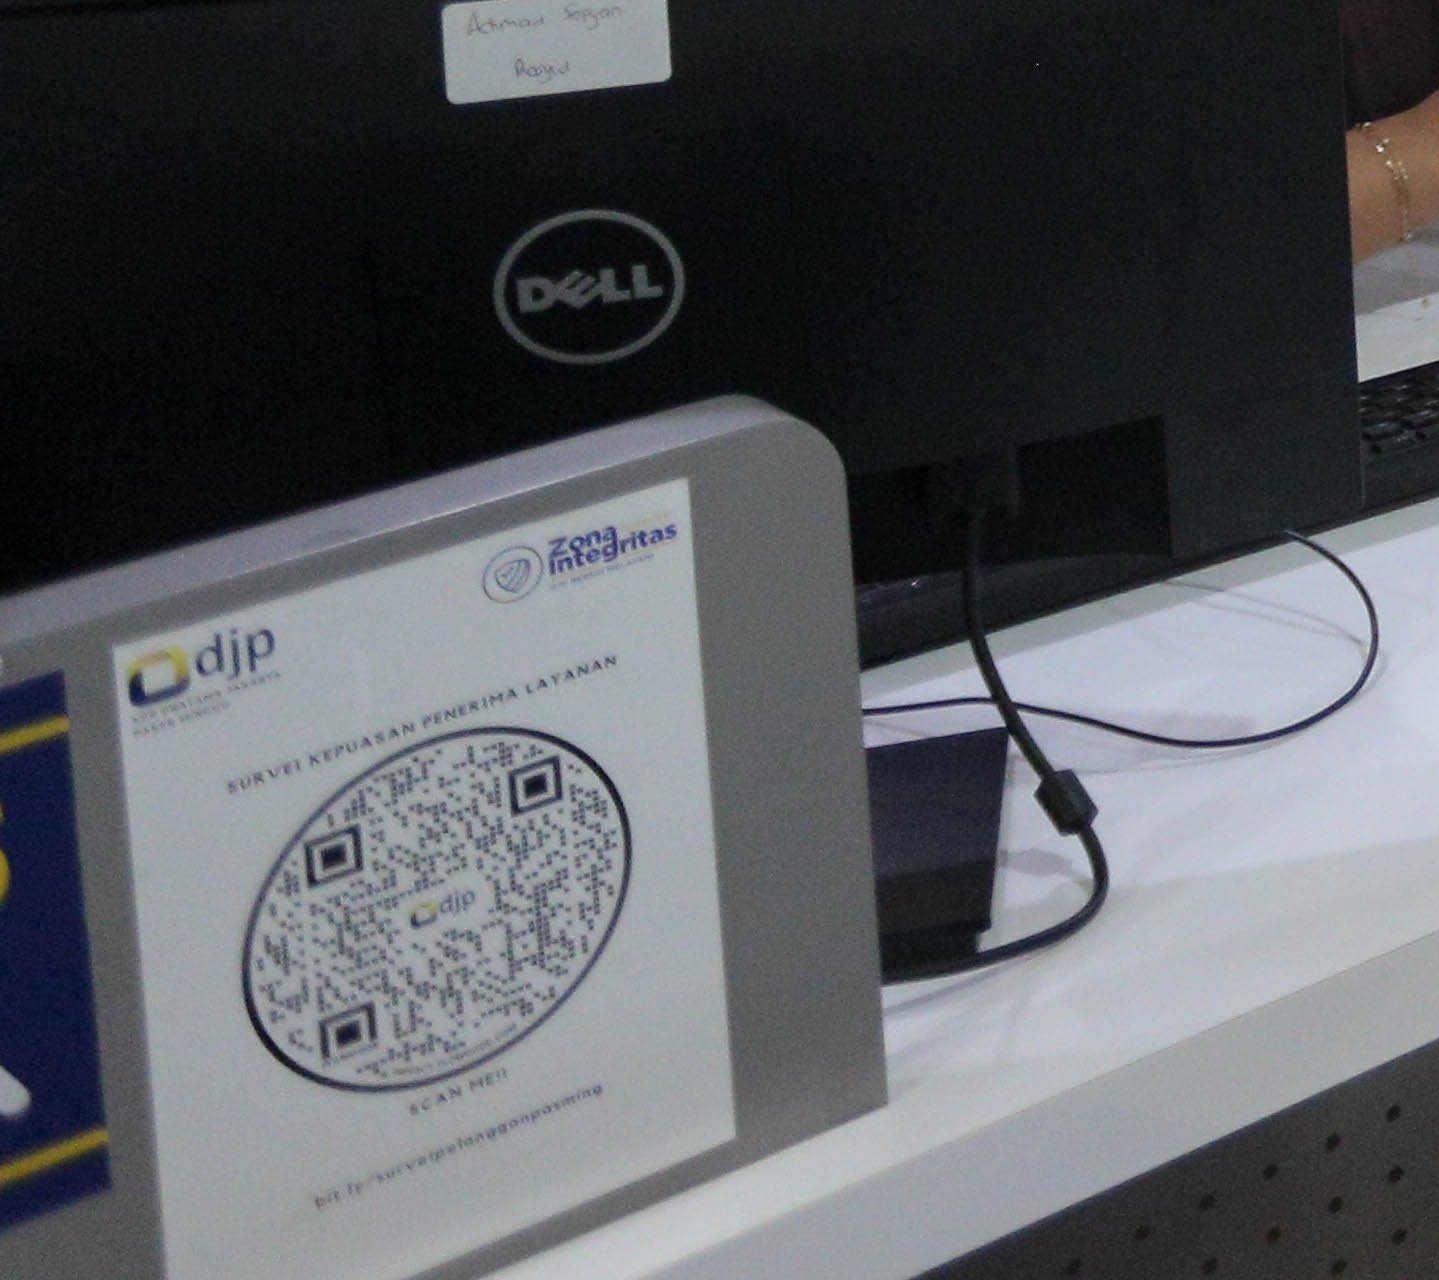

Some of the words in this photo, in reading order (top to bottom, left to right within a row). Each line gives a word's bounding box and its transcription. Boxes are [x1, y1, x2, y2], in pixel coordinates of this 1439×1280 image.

[517, 263, 663, 313] DELL
[548, 526, 617, 557] Zona
[548, 524, 678, 575] Integritas
[196, 626, 275, 679] djp
[227, 760, 303, 795] SURVEI
[309, 721, 416, 766] KEPUASAN
[421, 688, 518, 728] PENERIMA
[525, 654, 619, 695] LAYANAN
[440, 890, 476, 916] djp
[409, 1086, 462, 1116] SCAN
